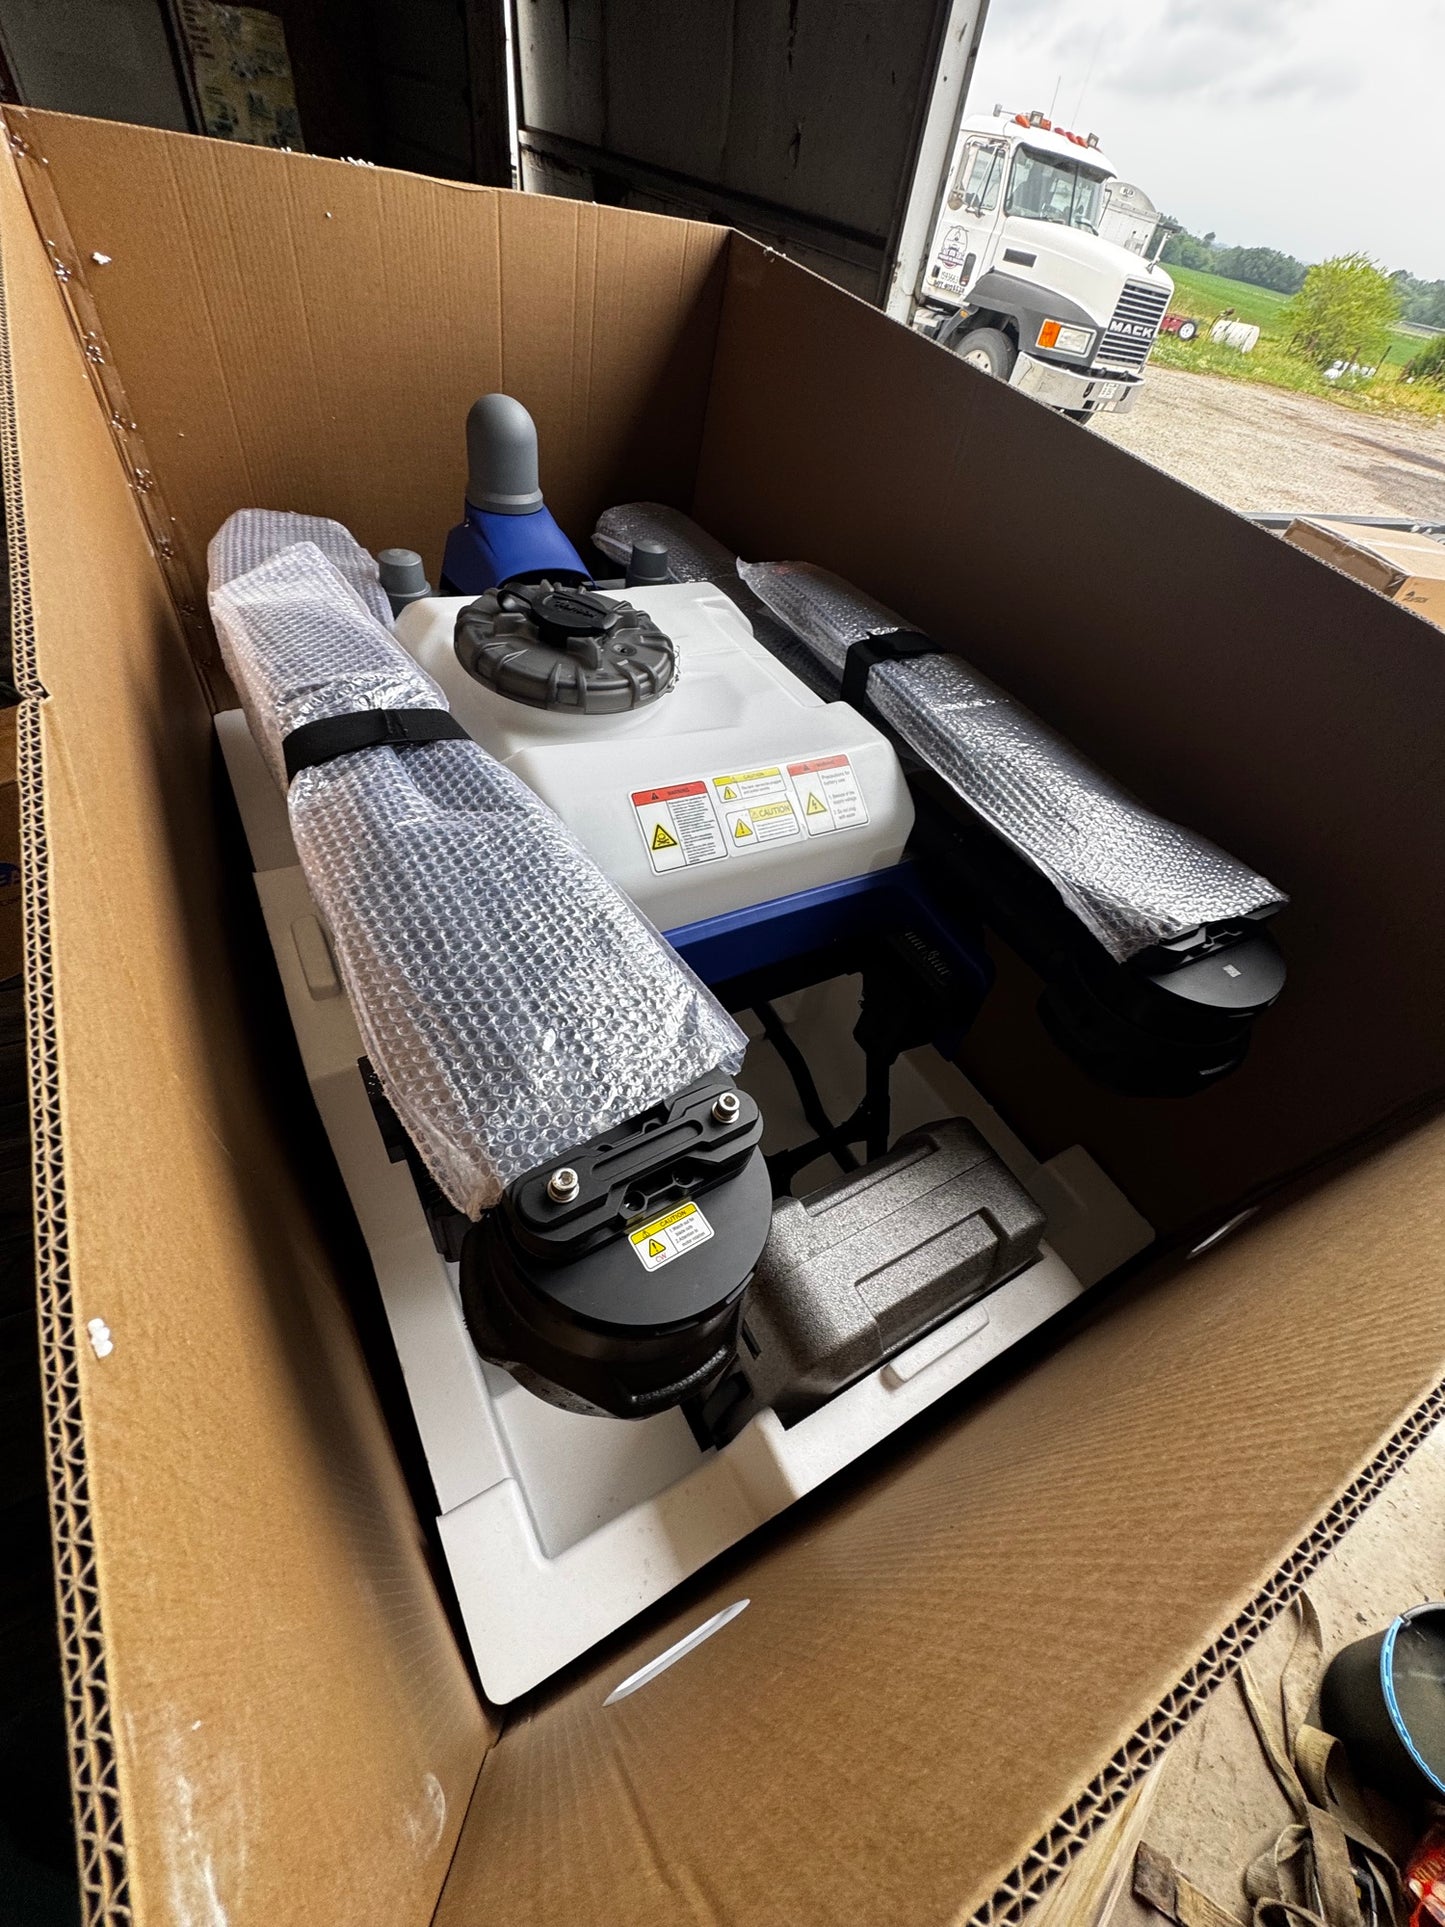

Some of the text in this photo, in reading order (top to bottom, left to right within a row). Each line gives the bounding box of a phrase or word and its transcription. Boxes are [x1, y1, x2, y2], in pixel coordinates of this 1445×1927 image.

[1109, 320, 1154, 338] MACK
[759, 805, 791, 817] CAUTION
[659, 1210, 687, 1227] CAUTION
